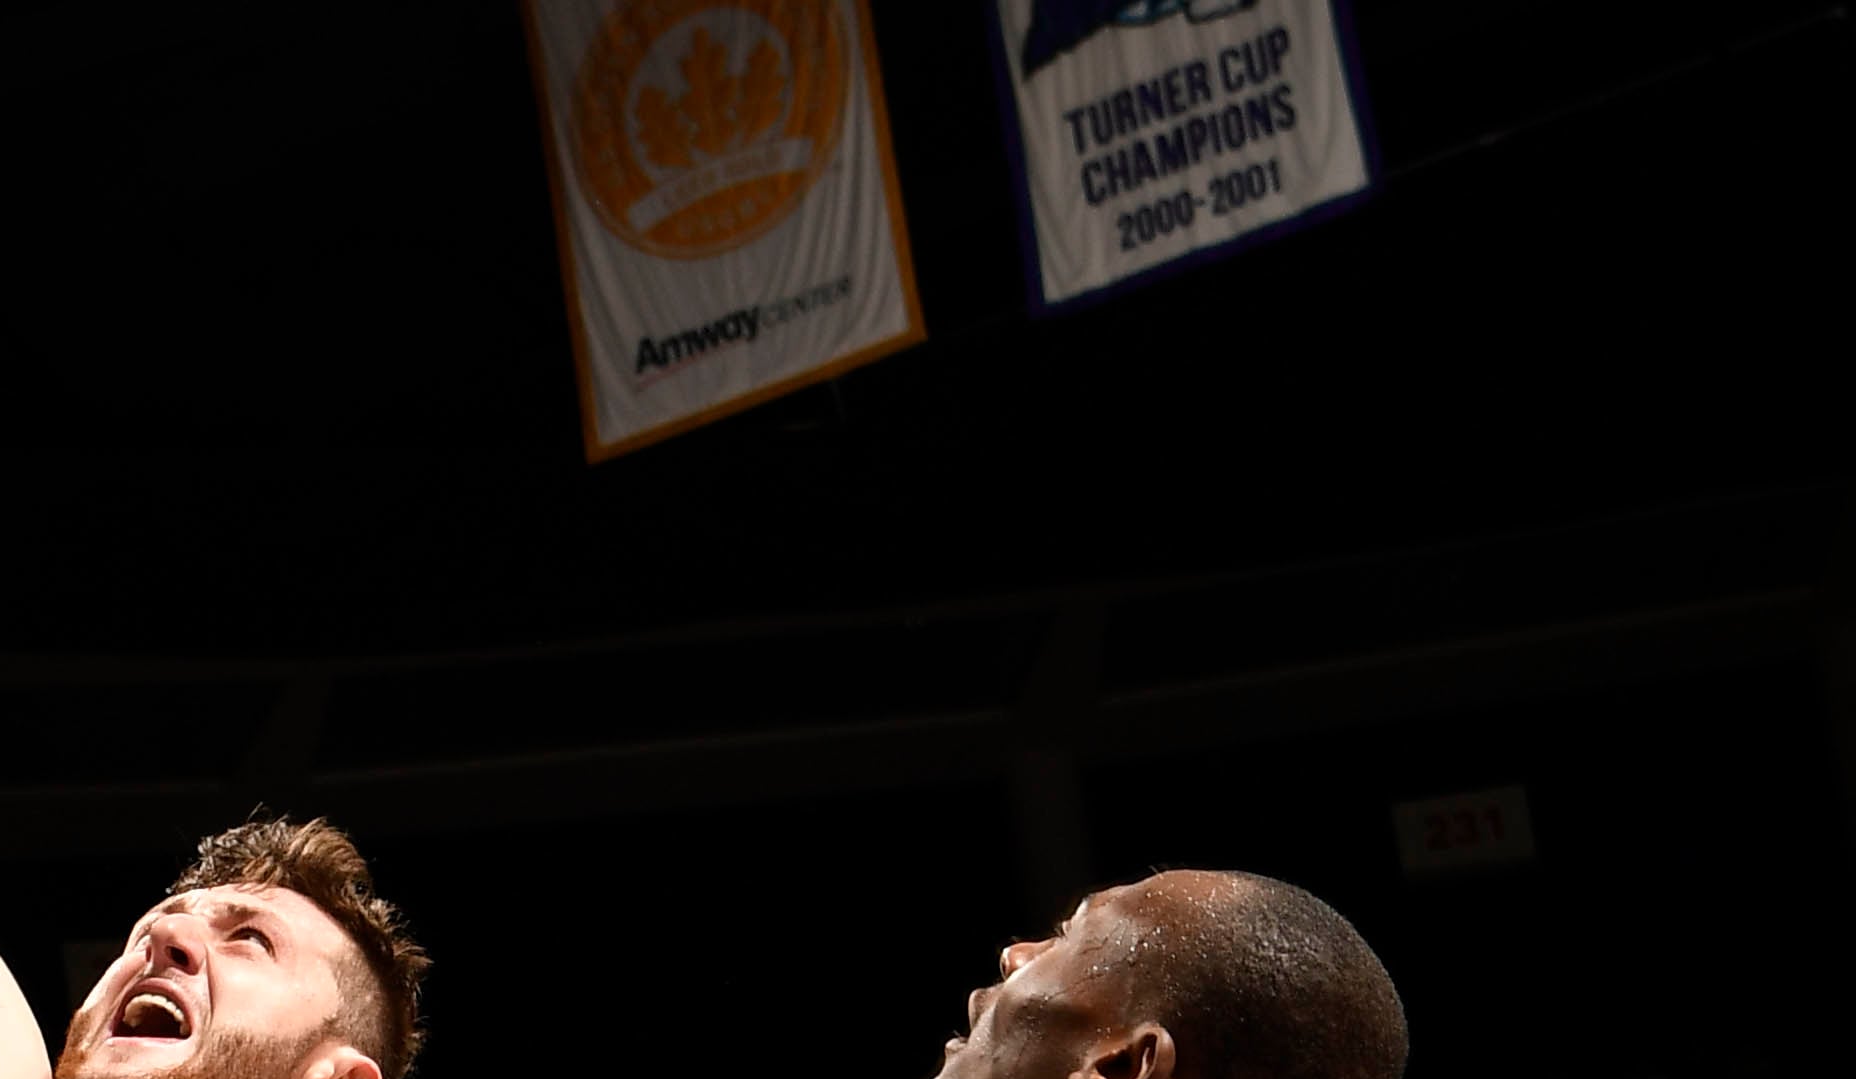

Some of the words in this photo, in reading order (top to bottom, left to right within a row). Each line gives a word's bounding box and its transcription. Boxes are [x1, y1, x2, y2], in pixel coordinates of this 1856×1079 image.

[1063, 60, 1211, 155] TURNER
[1219, 27, 1289, 94] CUP
[1081, 84, 1296, 206] CHAMPIONS
[1118, 160, 1281, 250] 2000-2001
[635, 306, 760, 374] Amway
[1424, 803, 1504, 850] 231
